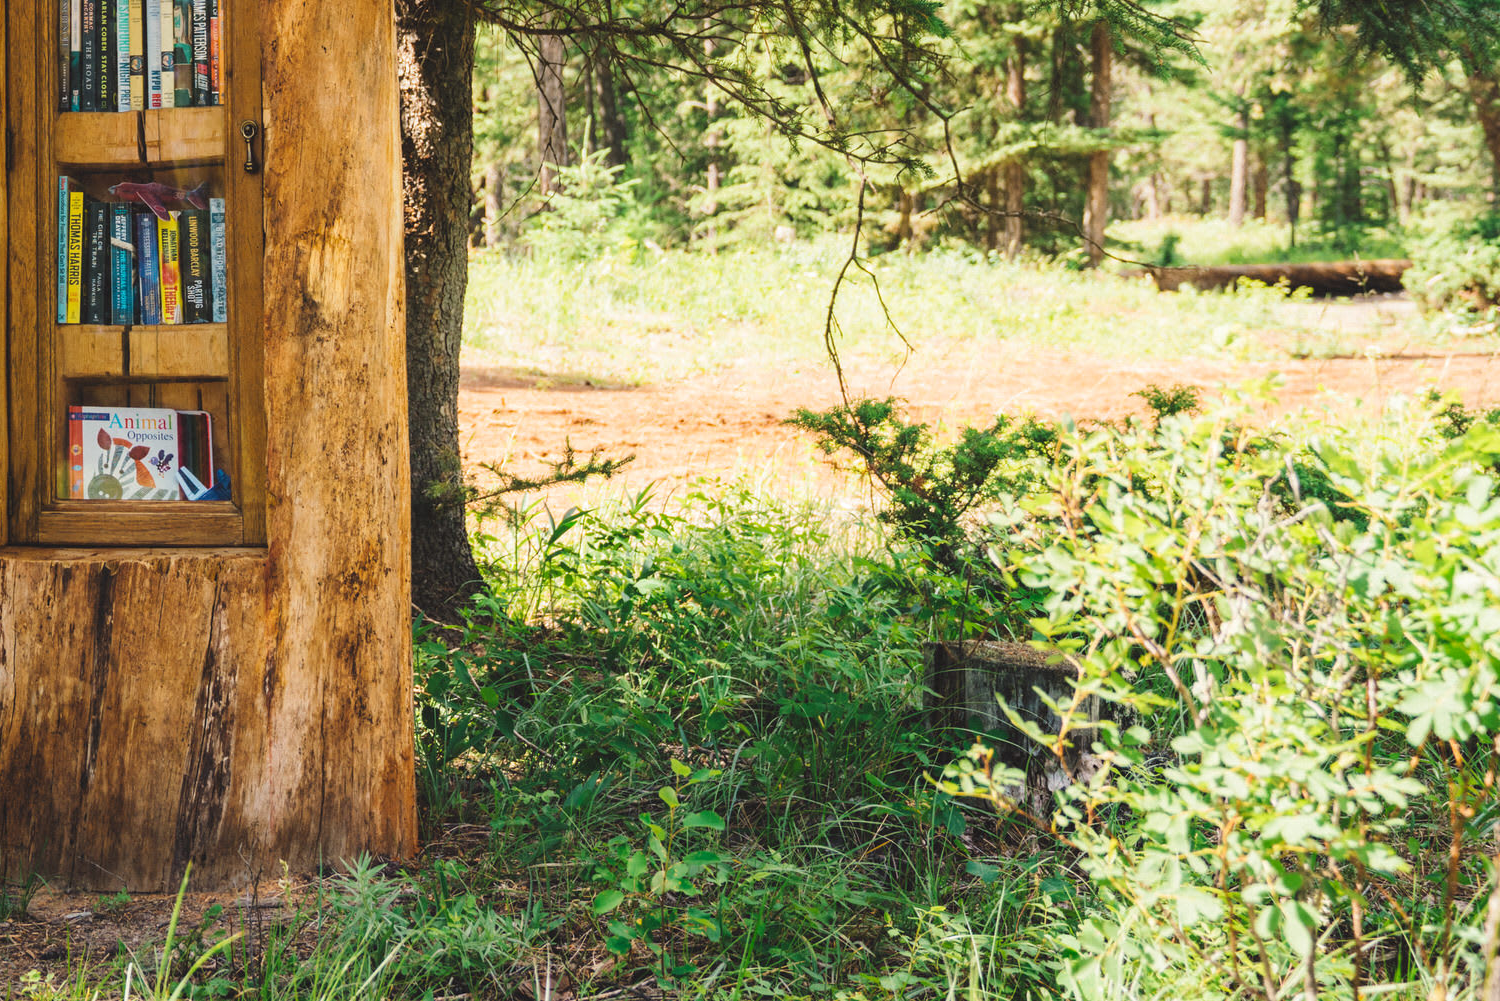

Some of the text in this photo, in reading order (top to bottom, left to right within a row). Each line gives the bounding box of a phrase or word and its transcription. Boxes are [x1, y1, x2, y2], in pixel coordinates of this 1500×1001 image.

[118, 6, 130, 52] SANDFORD
[193, 22, 207, 60] PATTERSON
[119, 62, 130, 86] NIGHT
[152, 70, 161, 90] NYPD
[197, 74, 208, 91] ALERT
[120, 88, 130, 106] PREY
[152, 93, 161, 107] RED
[70, 213, 81, 250] THOMAS
[215, 226, 223, 248] BRAD
[97, 241, 103, 251] ON
[188, 216, 200, 277] LINWOOD BARCLAY
[69, 252, 80, 285] HARRIS
[216, 250, 224, 270] THOR
[165, 286, 177, 321] THERAPY
[187, 285, 196, 303] SHOT
[194, 279, 203, 309] PARTING
[109, 413, 172, 430] Animal
[127, 430, 174, 442] Opposites
